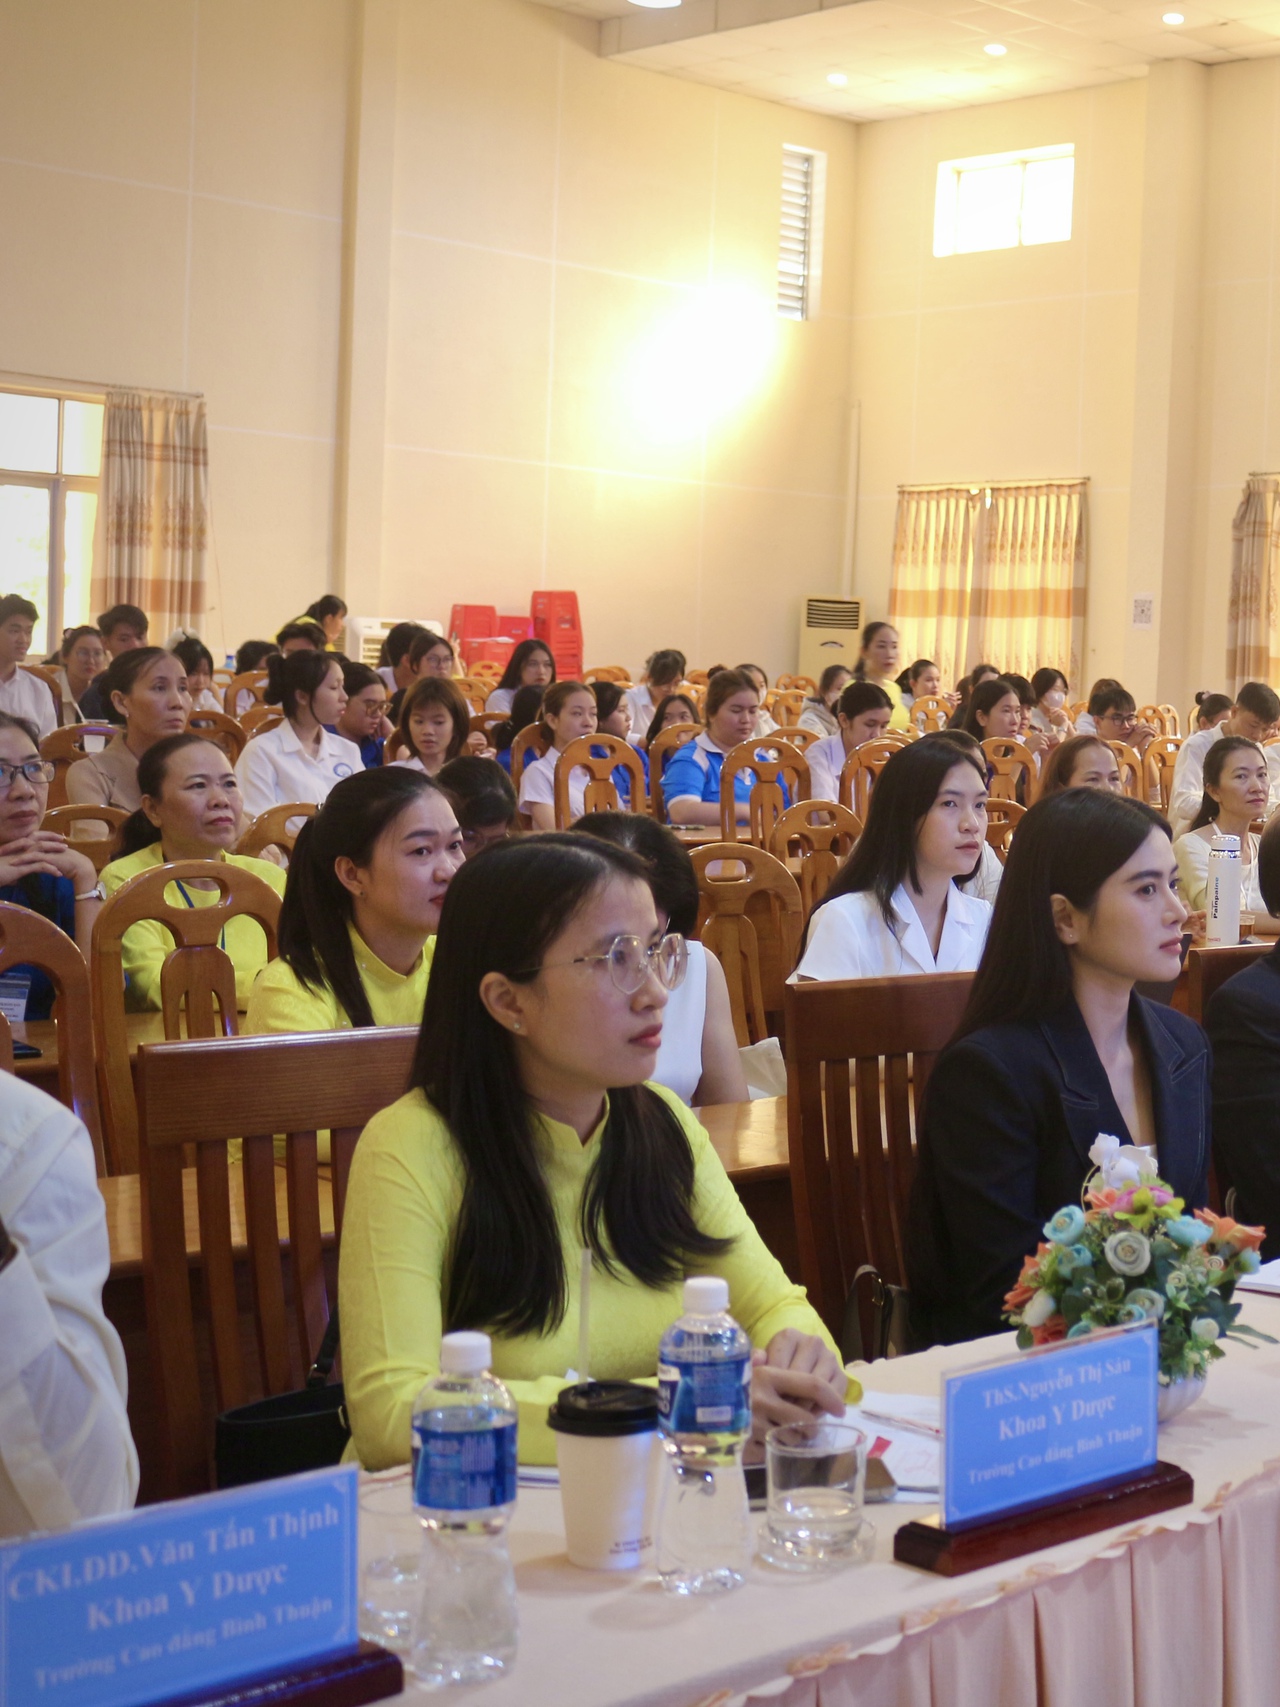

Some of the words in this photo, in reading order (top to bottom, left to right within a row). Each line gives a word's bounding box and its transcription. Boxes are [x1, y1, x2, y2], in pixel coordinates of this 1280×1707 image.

[982, 1367, 1074, 1409] ThS.Nguyễn
[1078, 1361, 1103, 1385] Thị
[1104, 1357, 1131, 1377] Sáu
[999, 1415, 1047, 1441] Khoa
[1051, 1402, 1066, 1425] Y
[1071, 1395, 1116, 1421] Dược
[969, 1461, 1015, 1484] Trường
[1018, 1455, 1042, 1470] Cao
[1077, 1435, 1103, 1454] Bình
[1107, 1424, 1143, 1444] Thuận
[202, 1515, 255, 1555] Tấn
[264, 1503, 340, 1540] Thịnh
[85, 1591, 169, 1631] Khoa
[179, 1577, 204, 1607] Y
[213, 1562, 289, 1600] Dược
[33, 1653, 116, 1691] Trường
[120, 1641, 163, 1667] Cao
[167, 1623, 217, 1656] đẳng
[221, 1612, 267, 1640] Bình
[273, 1596, 334, 1627] Thuận
